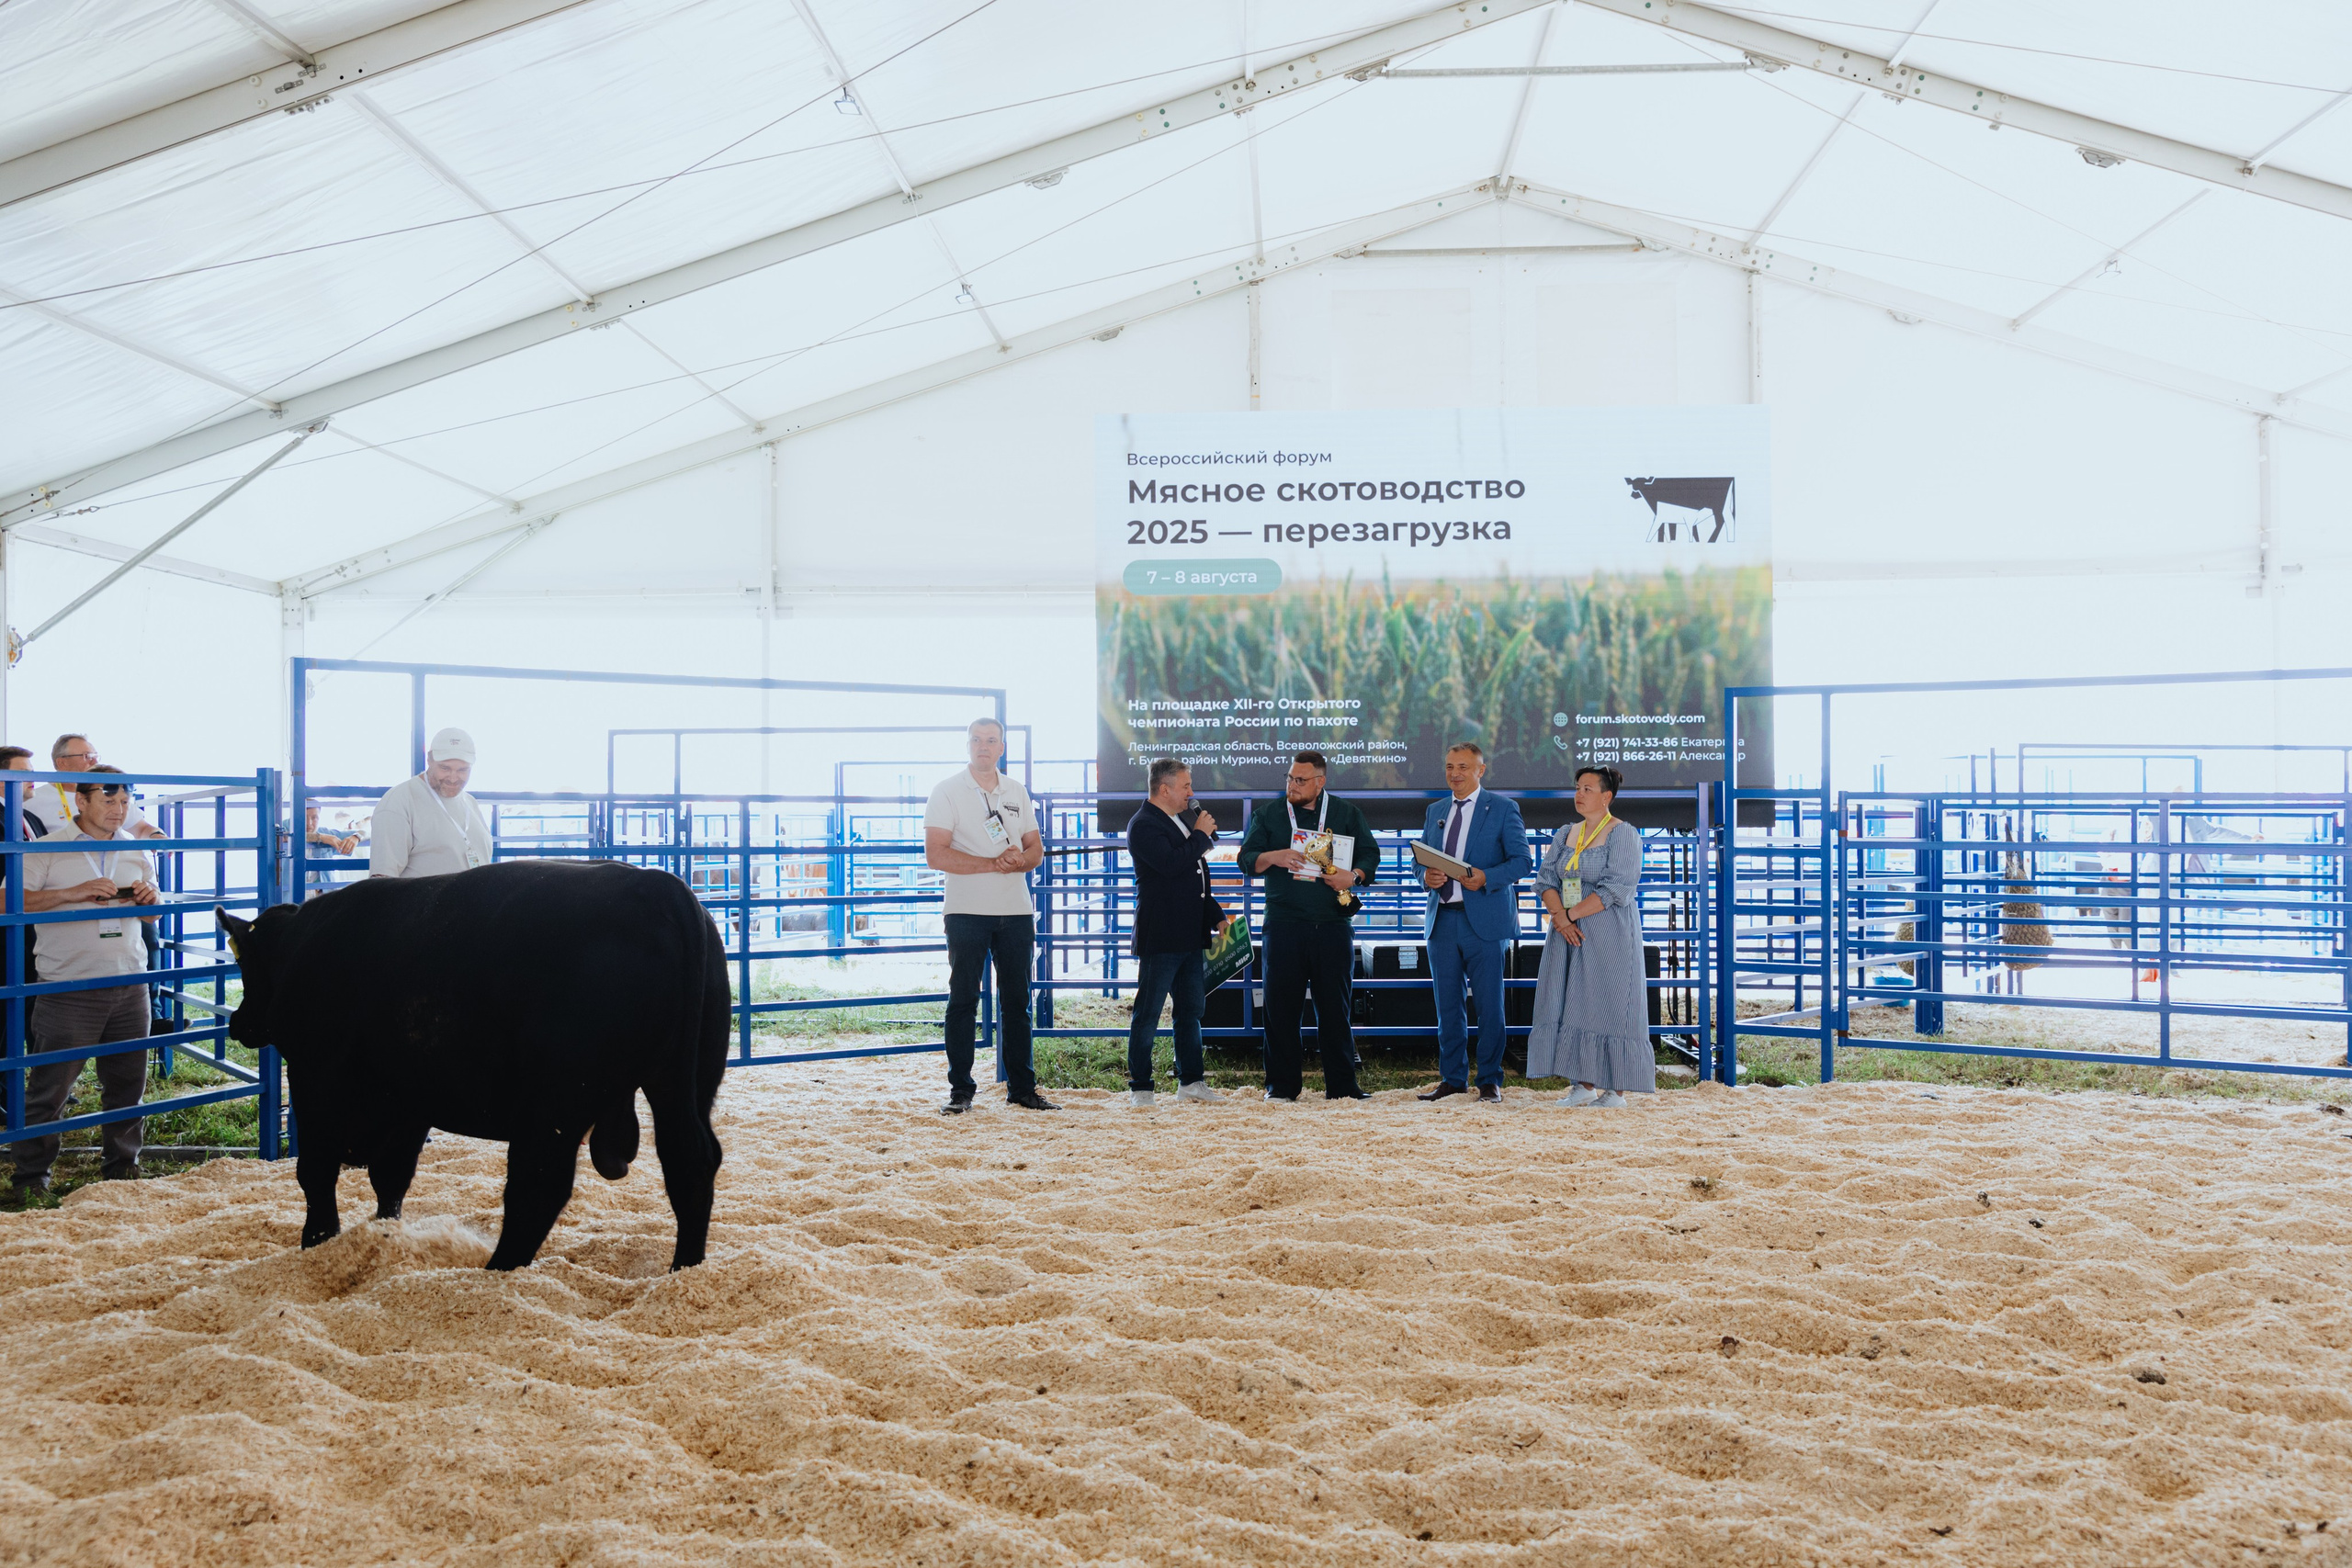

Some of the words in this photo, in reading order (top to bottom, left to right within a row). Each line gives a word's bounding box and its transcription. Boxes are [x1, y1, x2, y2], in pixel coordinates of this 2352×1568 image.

[1127, 450, 1267, 468] Всероссийский
[1272, 450, 1332, 468] форум
[1128, 479, 1266, 504] Мясное
[1276, 479, 1526, 504] скотоводство
[1126, 519, 1208, 545] 2025
[1263, 520, 1511, 548] перезагрузка
[1147, 570, 1158, 585] 7
[1174, 570, 1186, 584] 8
[1190, 570, 1258, 586] августа
[1128, 699, 1148, 711] На
[1152, 700, 1230, 713] площадке
[1278, 698, 1362, 712] Открытого
[1128, 717, 1220, 728] чемпионата
[1225, 716, 1280, 728] России
[1284, 716, 1304, 727] по
[1306, 716, 1359, 727] пахоте
[1575, 713, 1705, 726] forum.skotovody.com
[1128, 741, 1221, 753] Ленинградская
[1224, 740, 1273, 752] область,
[1276, 739, 1364, 750] Всеволожский
[1368, 739, 1408, 751] район,
[1576, 738, 1589, 748] +7
[1593, 737, 1620, 750] (921)
[1623, 737, 1679, 748] 741-33-86
[1681, 737, 1745, 749] Екатера
[1128, 757, 1136, 765] г.
[1181, 754, 1218, 765] район
[1221, 754, 1272, 766] Мурино,
[1273, 756, 1288, 764] ст.
[1330, 753, 1407, 765] «Девяткино»
[1576, 751, 1589, 761] +7
[1593, 750, 1620, 763] (921)
[1623, 750, 1677, 761] 866-26-11
[1679, 750, 1746, 762] Алексар
[1205, 915, 1248, 961] СХБ
[1235, 953, 1250, 968] МИР
